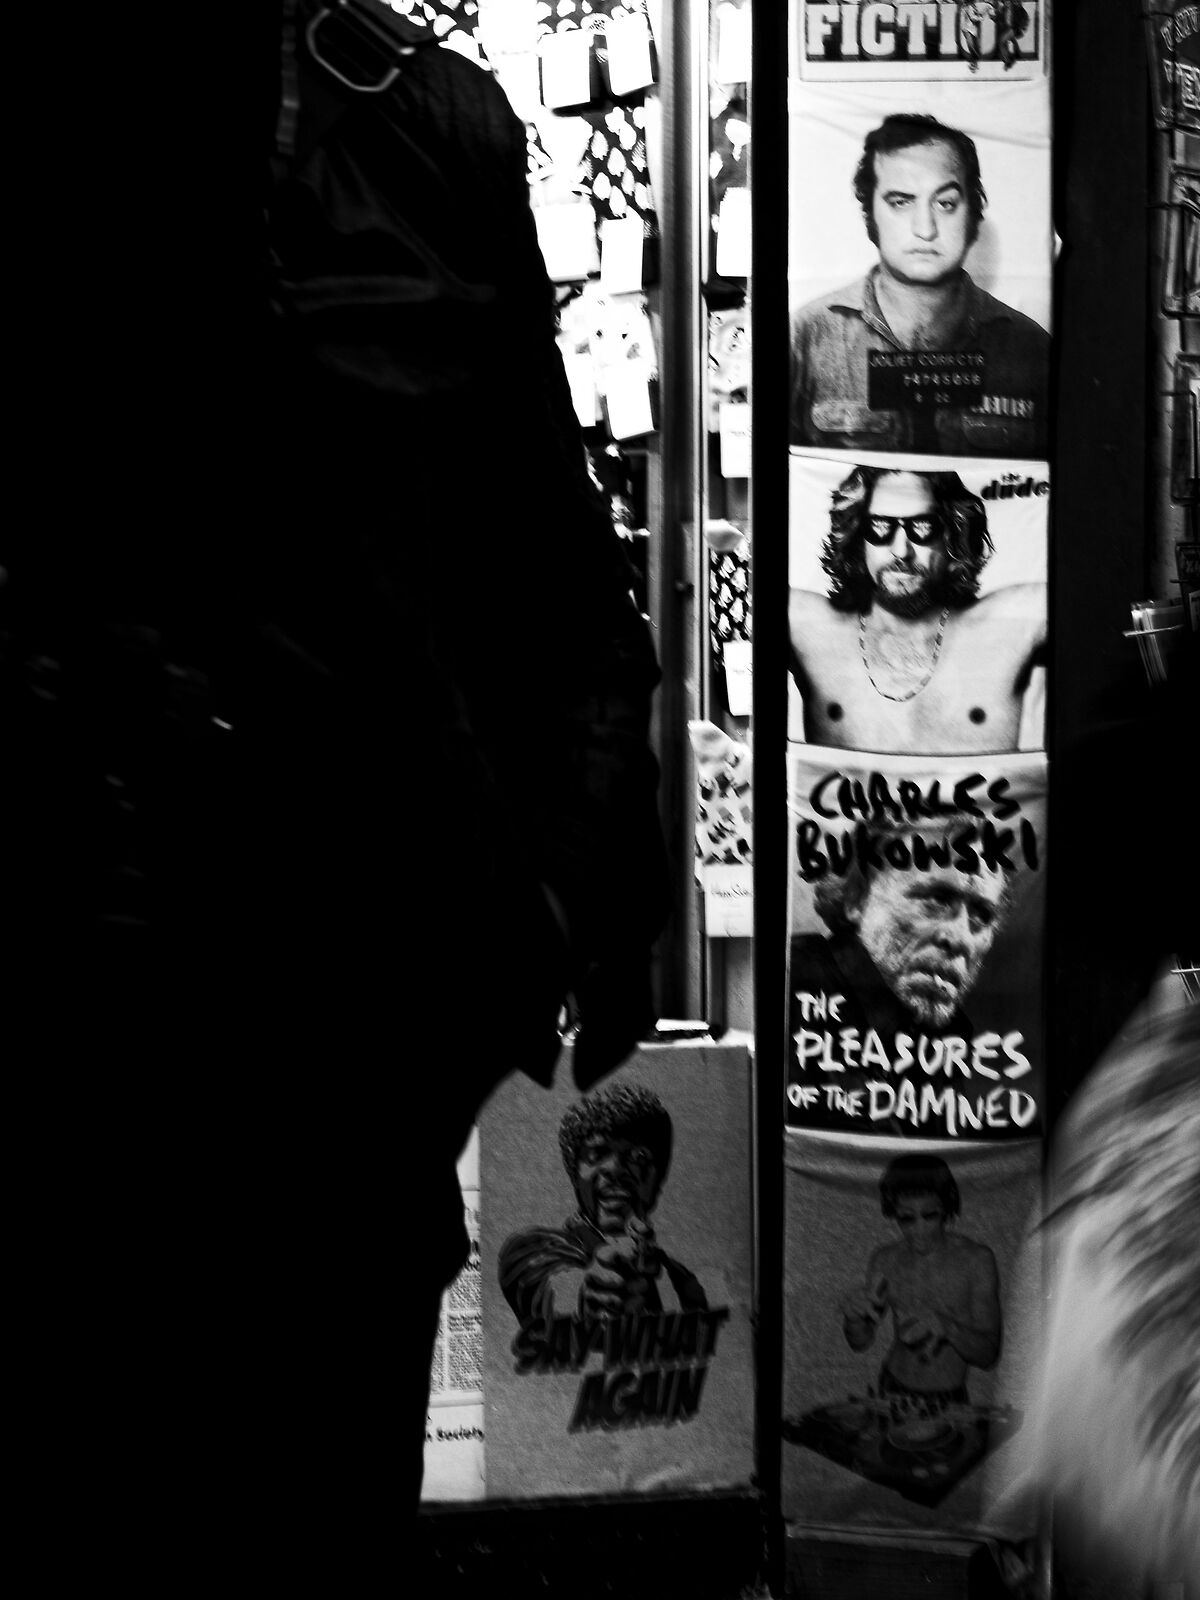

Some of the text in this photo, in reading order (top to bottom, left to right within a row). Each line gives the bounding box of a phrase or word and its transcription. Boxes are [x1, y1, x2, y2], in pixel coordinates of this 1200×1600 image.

[981, 477, 1050, 500] dude
[808, 771, 1022, 823] CHARLES
[797, 817, 1039, 883] BUKOWSKI
[795, 990, 846, 1023] THE
[793, 1027, 1032, 1081] PLEASURES
[786, 1077, 1037, 1136] OF THE DAMNED
[511, 1314, 604, 1375] SAY
[604, 1306, 729, 1371] WHAT
[567, 1365, 708, 1434] AGAIN
